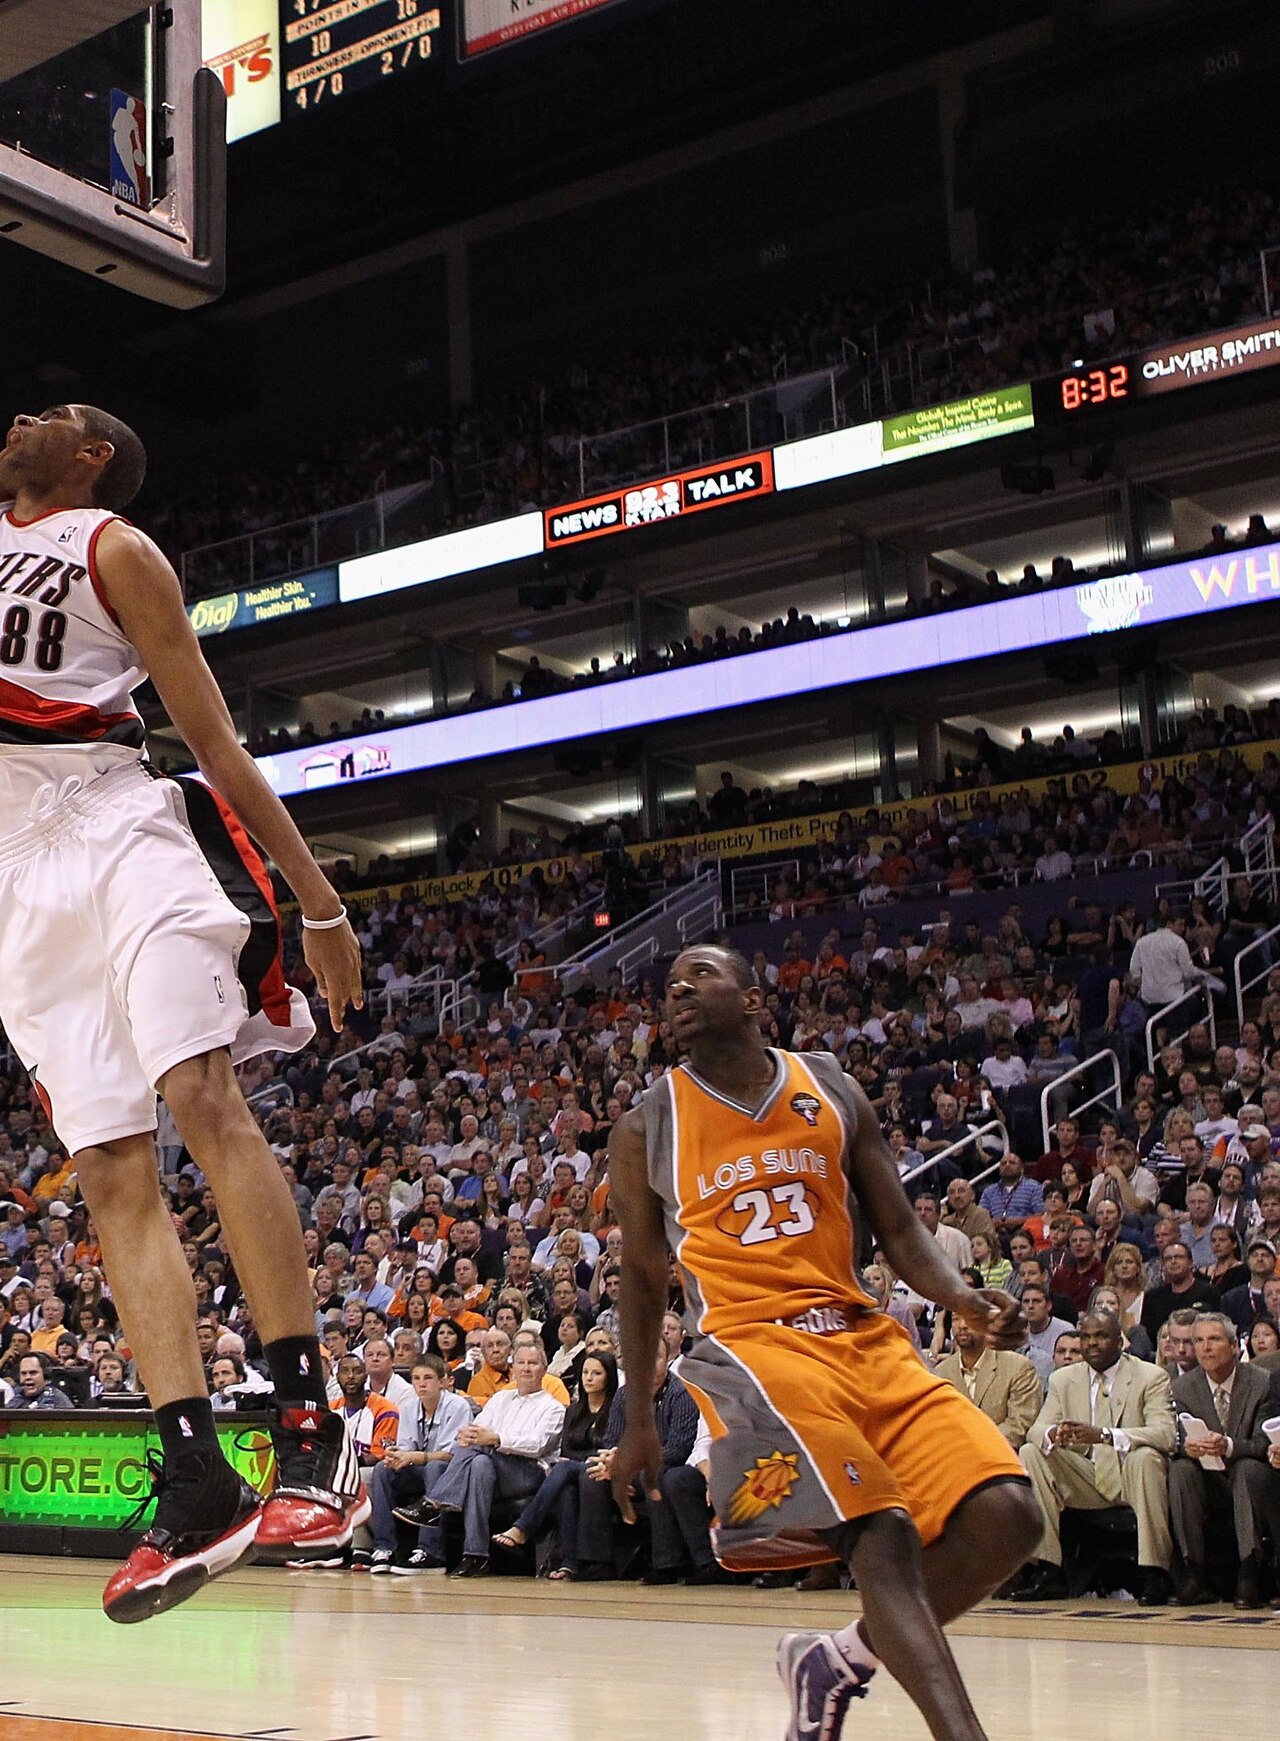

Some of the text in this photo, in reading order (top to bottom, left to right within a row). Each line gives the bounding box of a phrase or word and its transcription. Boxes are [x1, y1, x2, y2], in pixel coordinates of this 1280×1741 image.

[296, 9, 342, 36] POINTS
[296, 51, 354, 82] TURNOVERS
[360, 26, 414, 55] OPPONENT
[311, 30, 331, 58] 10
[111, 178, 136, 203] NBA
[1142, 345, 1219, 379] OLIVER
[1062, 364, 1129, 410] 8:32
[624, 480, 681, 514] 92.3
[687, 466, 756, 502] TALK
[553, 504, 619, 538] NEWS
[624, 501, 682, 528] KTAR
[245, 586, 283, 607] Healthier
[255, 600, 294, 621] Healthier
[191, 601, 234, 631] Dial
[693, 830, 756, 854] Identity
[758, 823, 803, 844] Theft
[415, 876, 475, 898] LifeLock
[696, 1154, 757, 1201] LOS
[731, 1180, 816, 1247] 23
